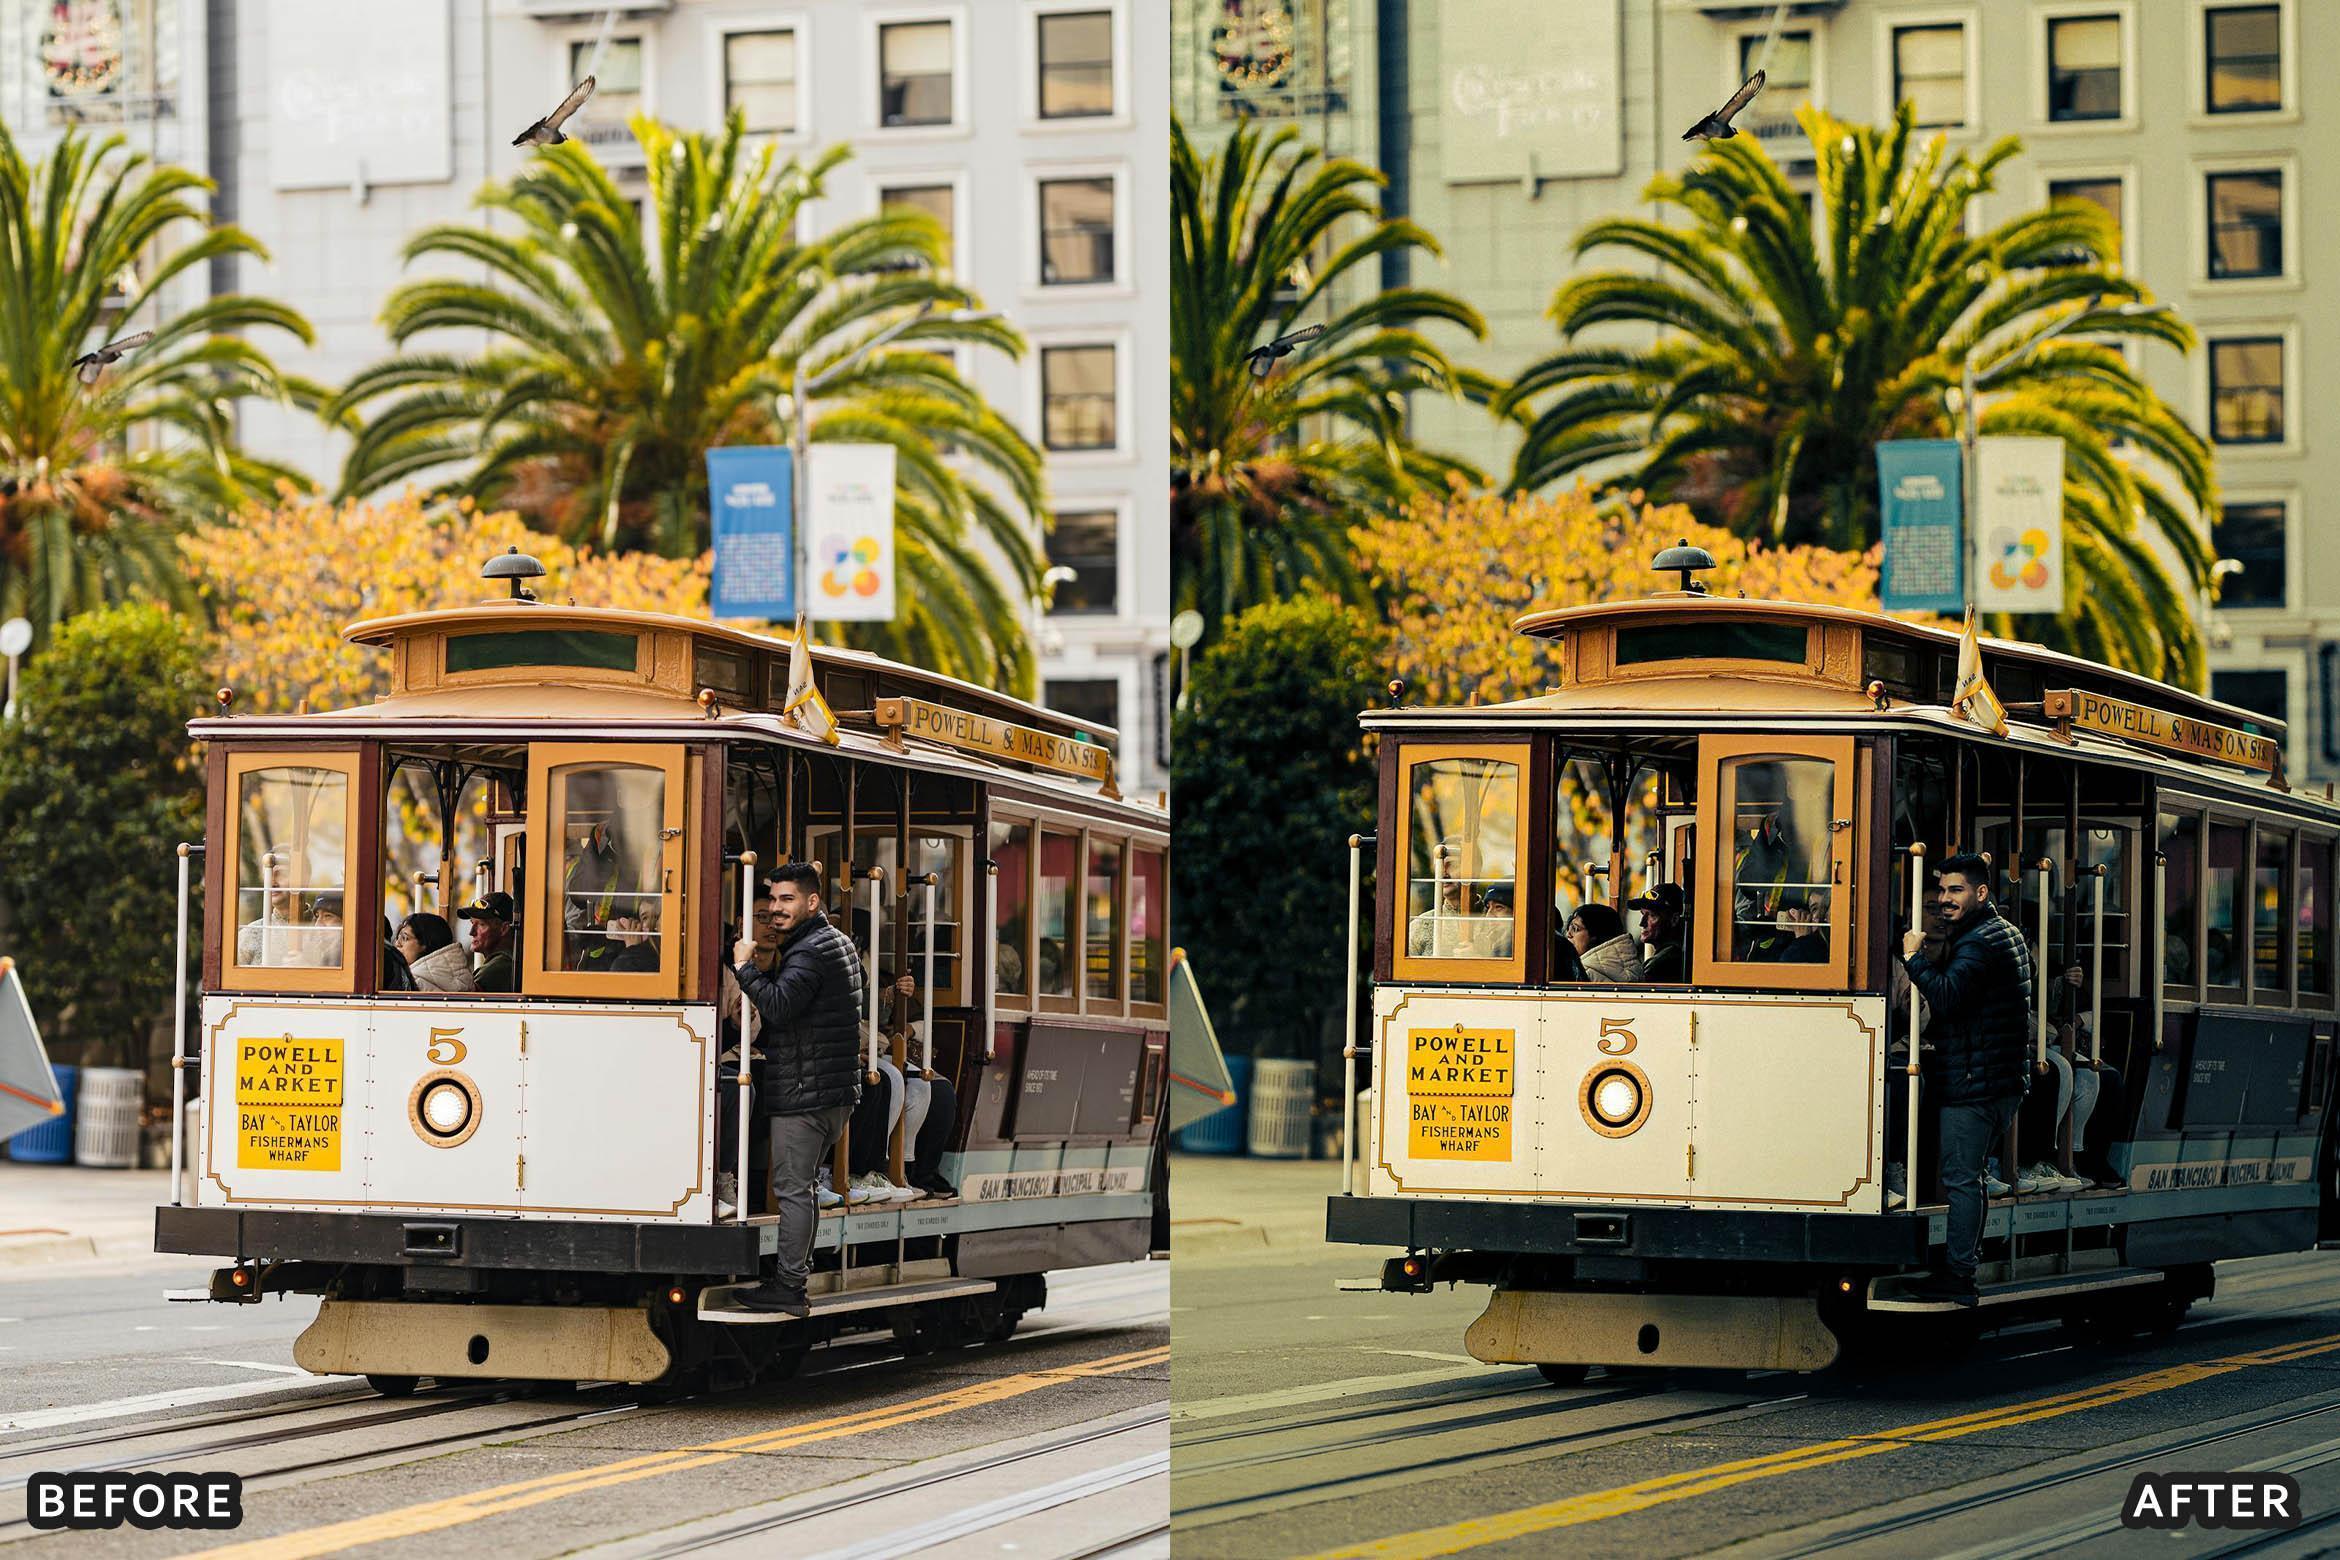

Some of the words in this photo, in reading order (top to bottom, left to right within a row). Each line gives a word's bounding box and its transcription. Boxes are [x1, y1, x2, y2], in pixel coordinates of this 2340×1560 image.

[915, 706, 992, 745] POWELL
[1003, 727, 1015, 751] &
[1022, 732, 1079, 766] MASON
[2084, 698, 2160, 737] POWELL
[2171, 719, 2183, 743] &
[2190, 724, 2247, 757] MASON
[1415, 1036, 1509, 1053] POWELL
[1597, 1017, 1638, 1056] 5
[243, 1045, 338, 1063] POWELL
[426, 1026, 468, 1066] 5
[1438, 1054, 1484, 1066] AND
[267, 1064, 313, 1075] AND
[1411, 1067, 1509, 1083] MARKET
[240, 1077, 338, 1093] MARKET
[1413, 1104, 1436, 1121] BAY
[1441, 1105, 1456, 1122] AND
[1460, 1104, 1509, 1122] TAYLOR
[242, 1113, 265, 1131] BAY
[270, 1114, 285, 1132] AND
[289, 1114, 338, 1132] TAYLOR
[1421, 1126, 1500, 1138] FISHERMANS
[250, 1136, 329, 1148] FISHERMANS
[1440, 1140, 1481, 1152] WHARF
[268, 1149, 310, 1162] WHARF
[2147, 1169, 2169, 1189] SAN
[2169, 1165, 2218, 1188] FANCISCO
[2220, 1162, 2260, 1185] MNICIPAL
[979, 1179, 999, 1200] SAN
[1000, 1175, 1049, 1198] FANCISCO
[1051, 1172, 1092, 1195] MNICIPAL
